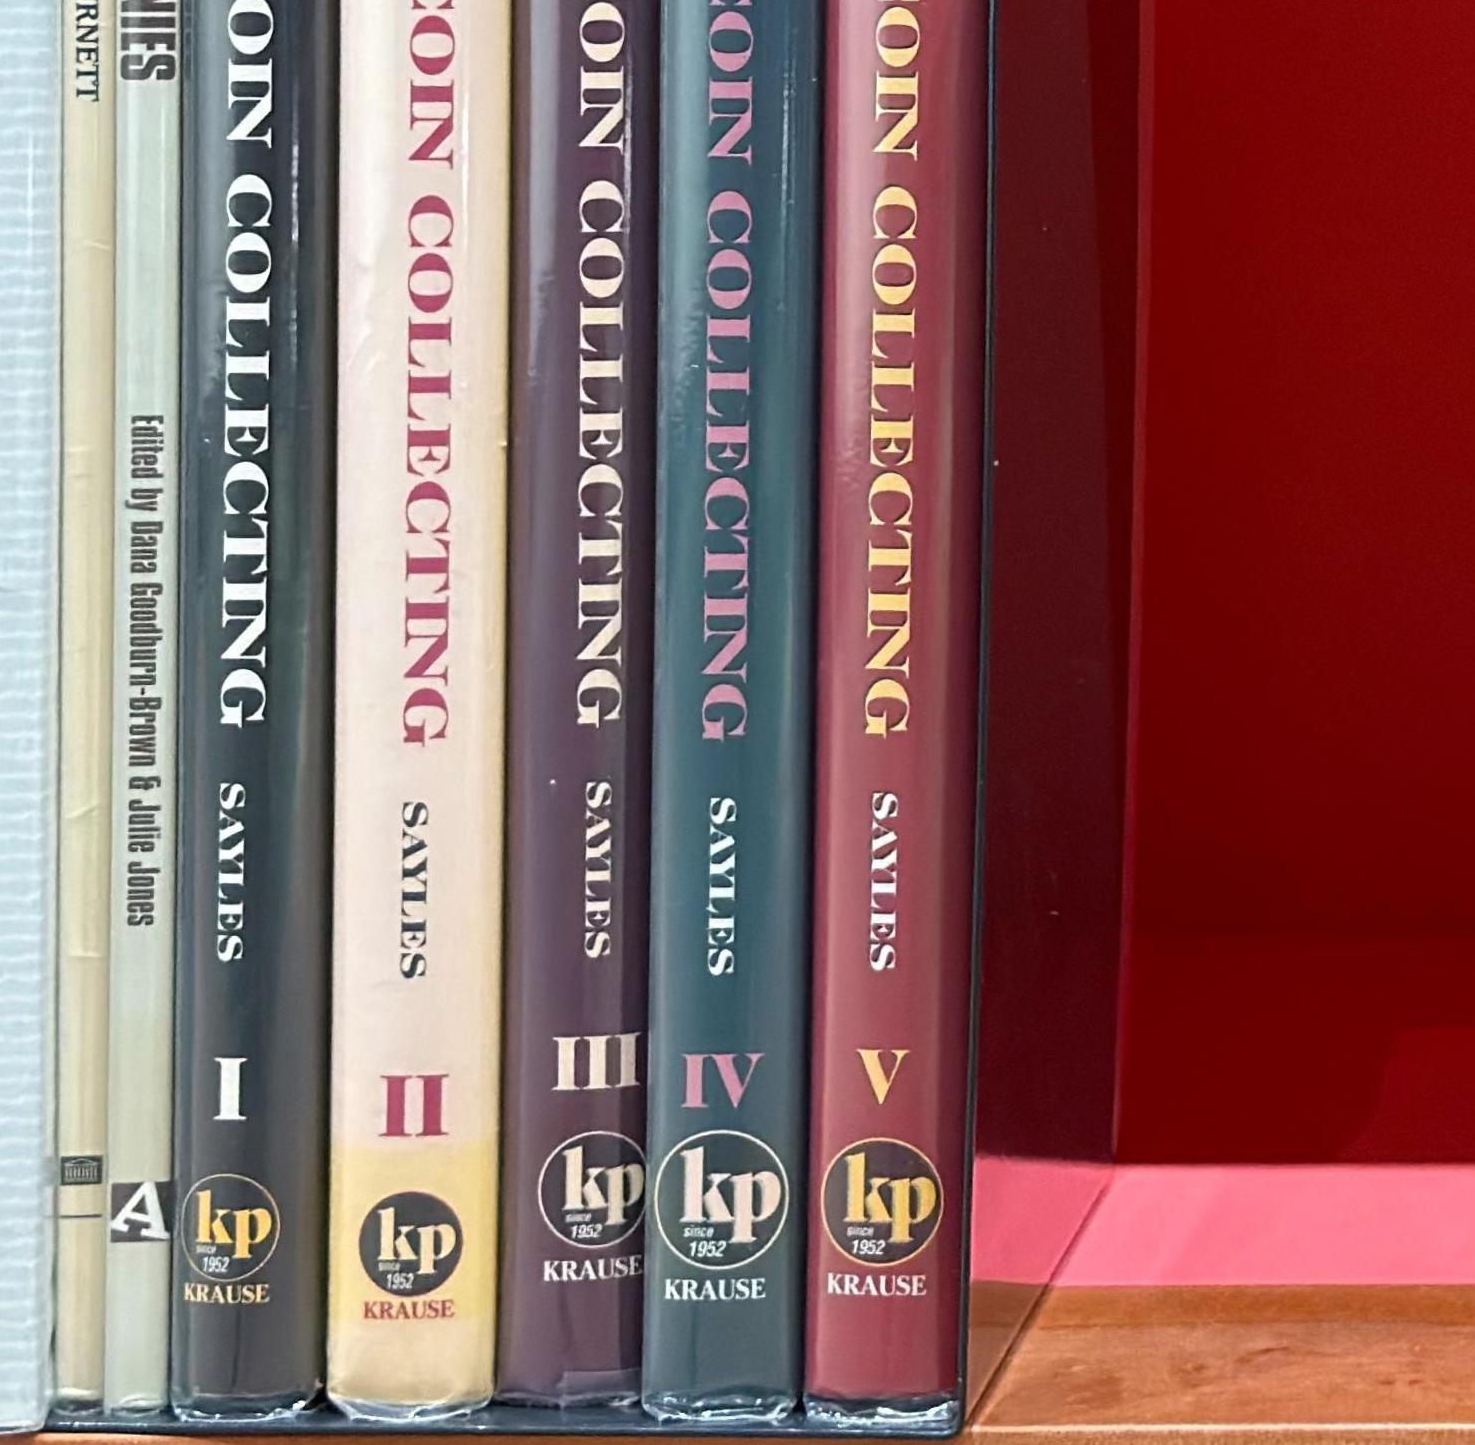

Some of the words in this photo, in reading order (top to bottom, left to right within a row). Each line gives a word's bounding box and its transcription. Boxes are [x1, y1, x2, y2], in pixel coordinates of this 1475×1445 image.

[130, 415, 165, 480] Edited
[219, 173, 273, 730] COLLECTING
[401, 194, 455, 747] COLLECTING
[576, 178, 626, 730] COLLECTING
[702, 190, 753, 743] COLLECTING
[864, 184, 918, 738] COLLECTING
[124, 487, 164, 512] by
[129, 521, 164, 574] Dana
[128, 582, 163, 768] Goodburn-Brown
[128, 775, 162, 791] &
[127, 798, 162, 853] Julie
[126, 860, 161, 927] Jones
[215, 782, 246, 963] SAYLES
[399, 801, 428, 979] SAYLES
[583, 781, 613, 959] SAYLES
[706, 797, 738, 976] SAYLES
[868, 791, 899, 971] SAYLES
[213, 1057, 248, 1121] I
[551, 1032, 641, 1092] III
[680, 1053, 764, 1109] IV
[855, 1048, 911, 1105] V
[378, 1073, 450, 1137] II
[110, 1180, 171, 1240] A
[562, 1145, 645, 1225] kp
[679, 1145, 782, 1244] kp
[842, 1151, 937, 1244] kp
[194, 1189, 272, 1259] kp
[376, 1206, 457, 1275] kp
[571, 1223, 603, 1239] 1952
[689, 1240, 727, 1258] 1952
[852, 1239, 887, 1255] 1952
[183, 1282, 271, 1304] KRAUSE
[202, 1256, 230, 1273] 1952
[387, 1273, 415, 1289] 1952
[543, 1254, 644, 1282] KRAUSE
[664, 1278, 767, 1301] KRAUSE
[827, 1272, 927, 1296] KRAUSE
[362, 1299, 456, 1320] KRAUSE
